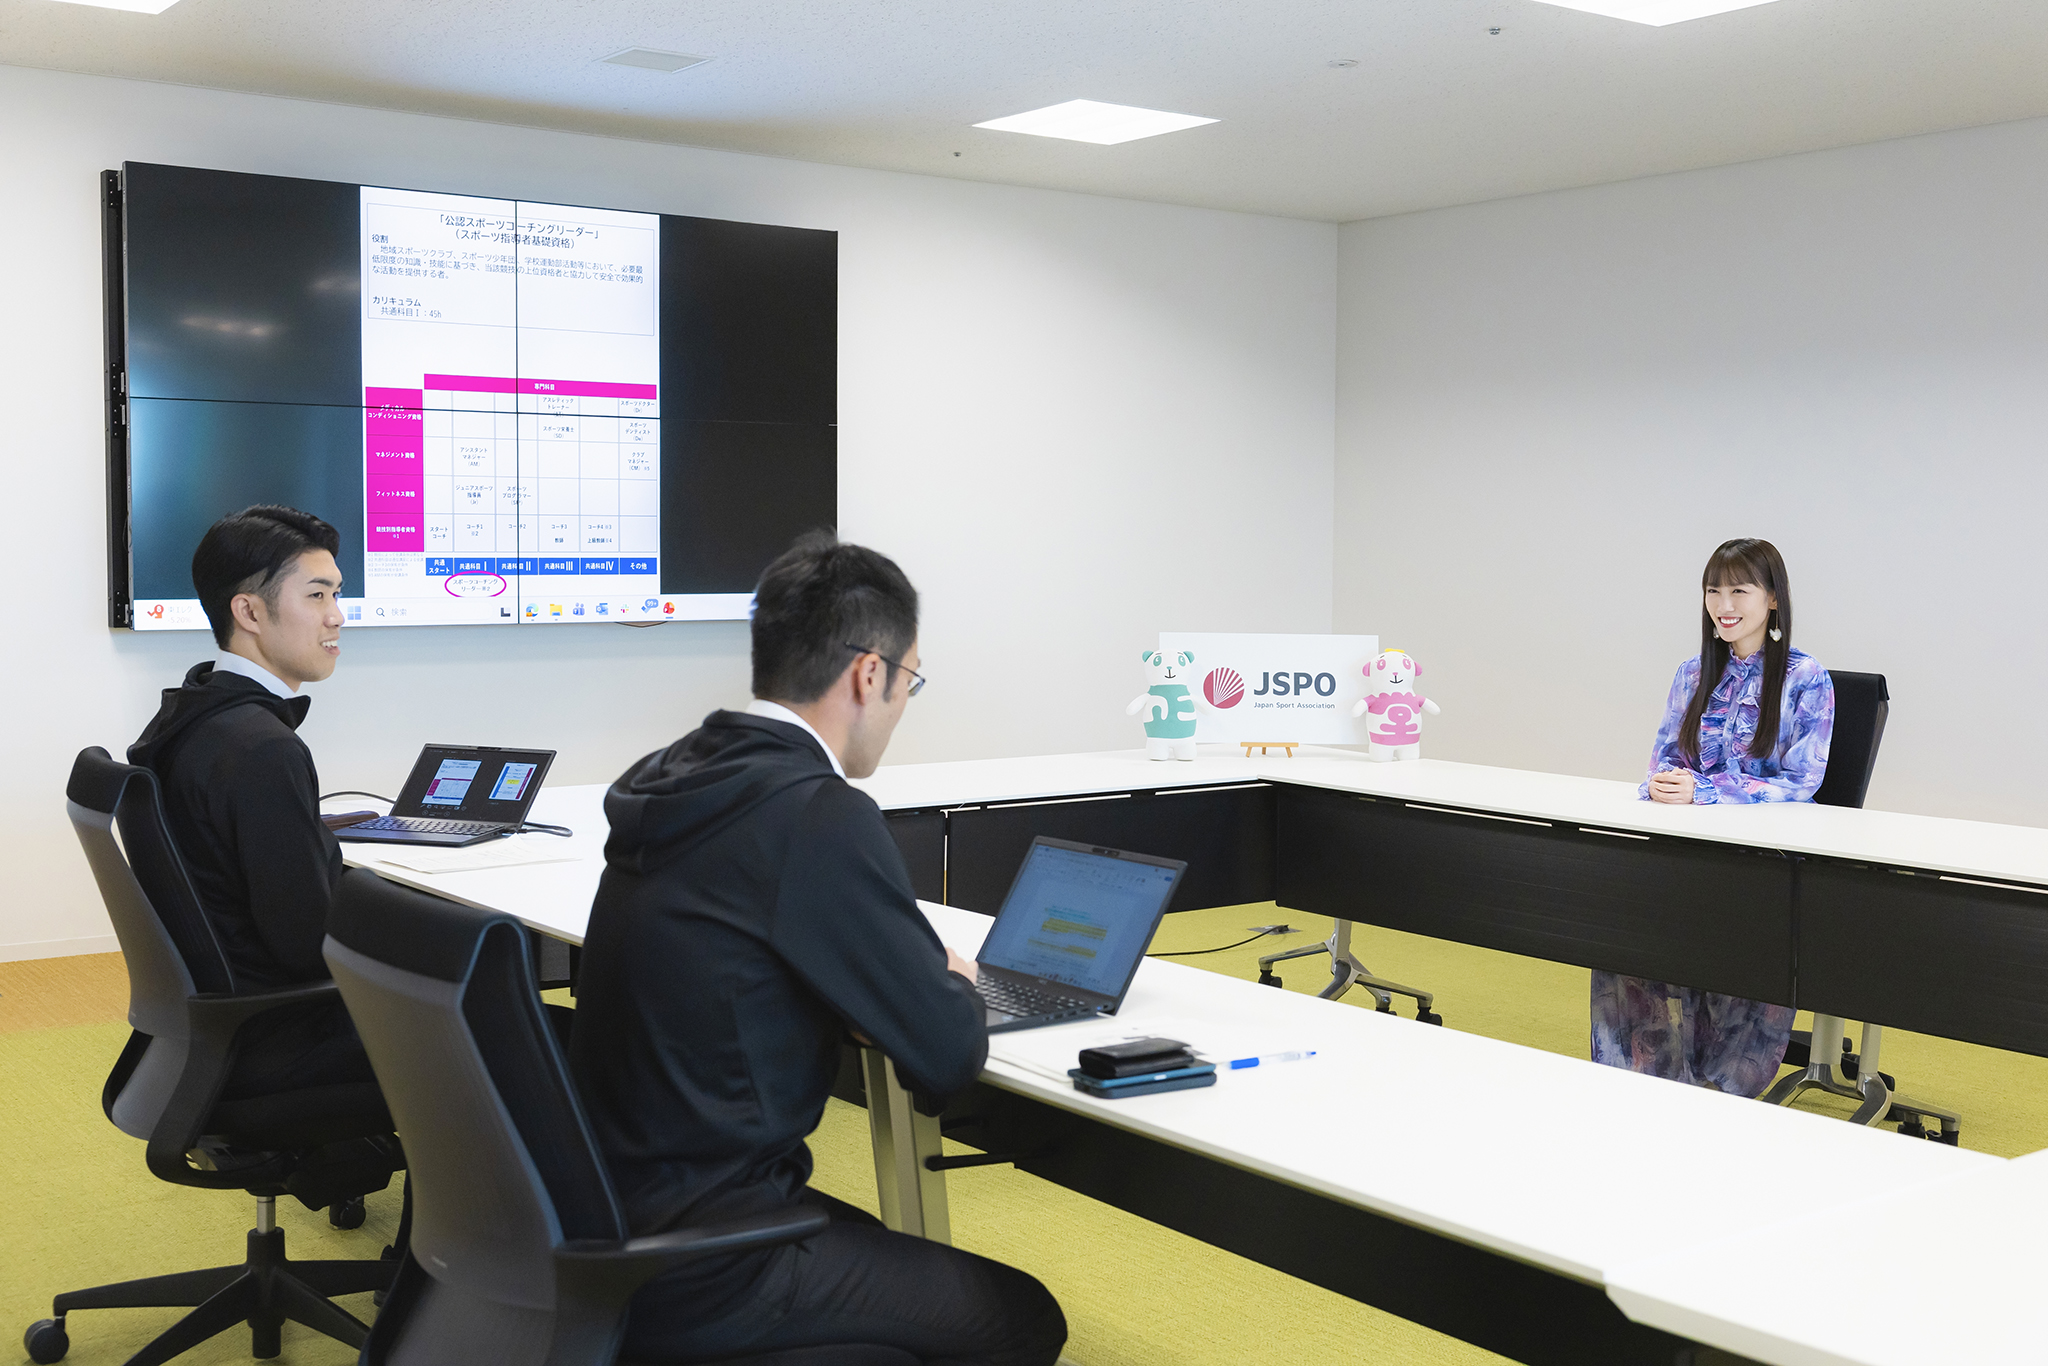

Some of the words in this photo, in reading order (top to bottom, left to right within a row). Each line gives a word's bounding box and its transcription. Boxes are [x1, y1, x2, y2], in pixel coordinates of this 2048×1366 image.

[439, 213, 599, 240] 「公認スポーツコーチングリーダー」
[371, 233, 389, 244] 役割
[455, 228, 575, 249] （スポーツ指導者基礎資格）
[371, 265, 449, 280] な活動を提供する者。
[372, 296, 421, 307] カリキュラム
[534, 383, 555, 391] 専門科目
[375, 451, 416, 459] マネジメント資格
[434, 558, 446, 566] 共通
[630, 562, 648, 570] その他
[1253, 671, 1336, 697] JSPO
[1276, 701, 1295, 709] Sport
